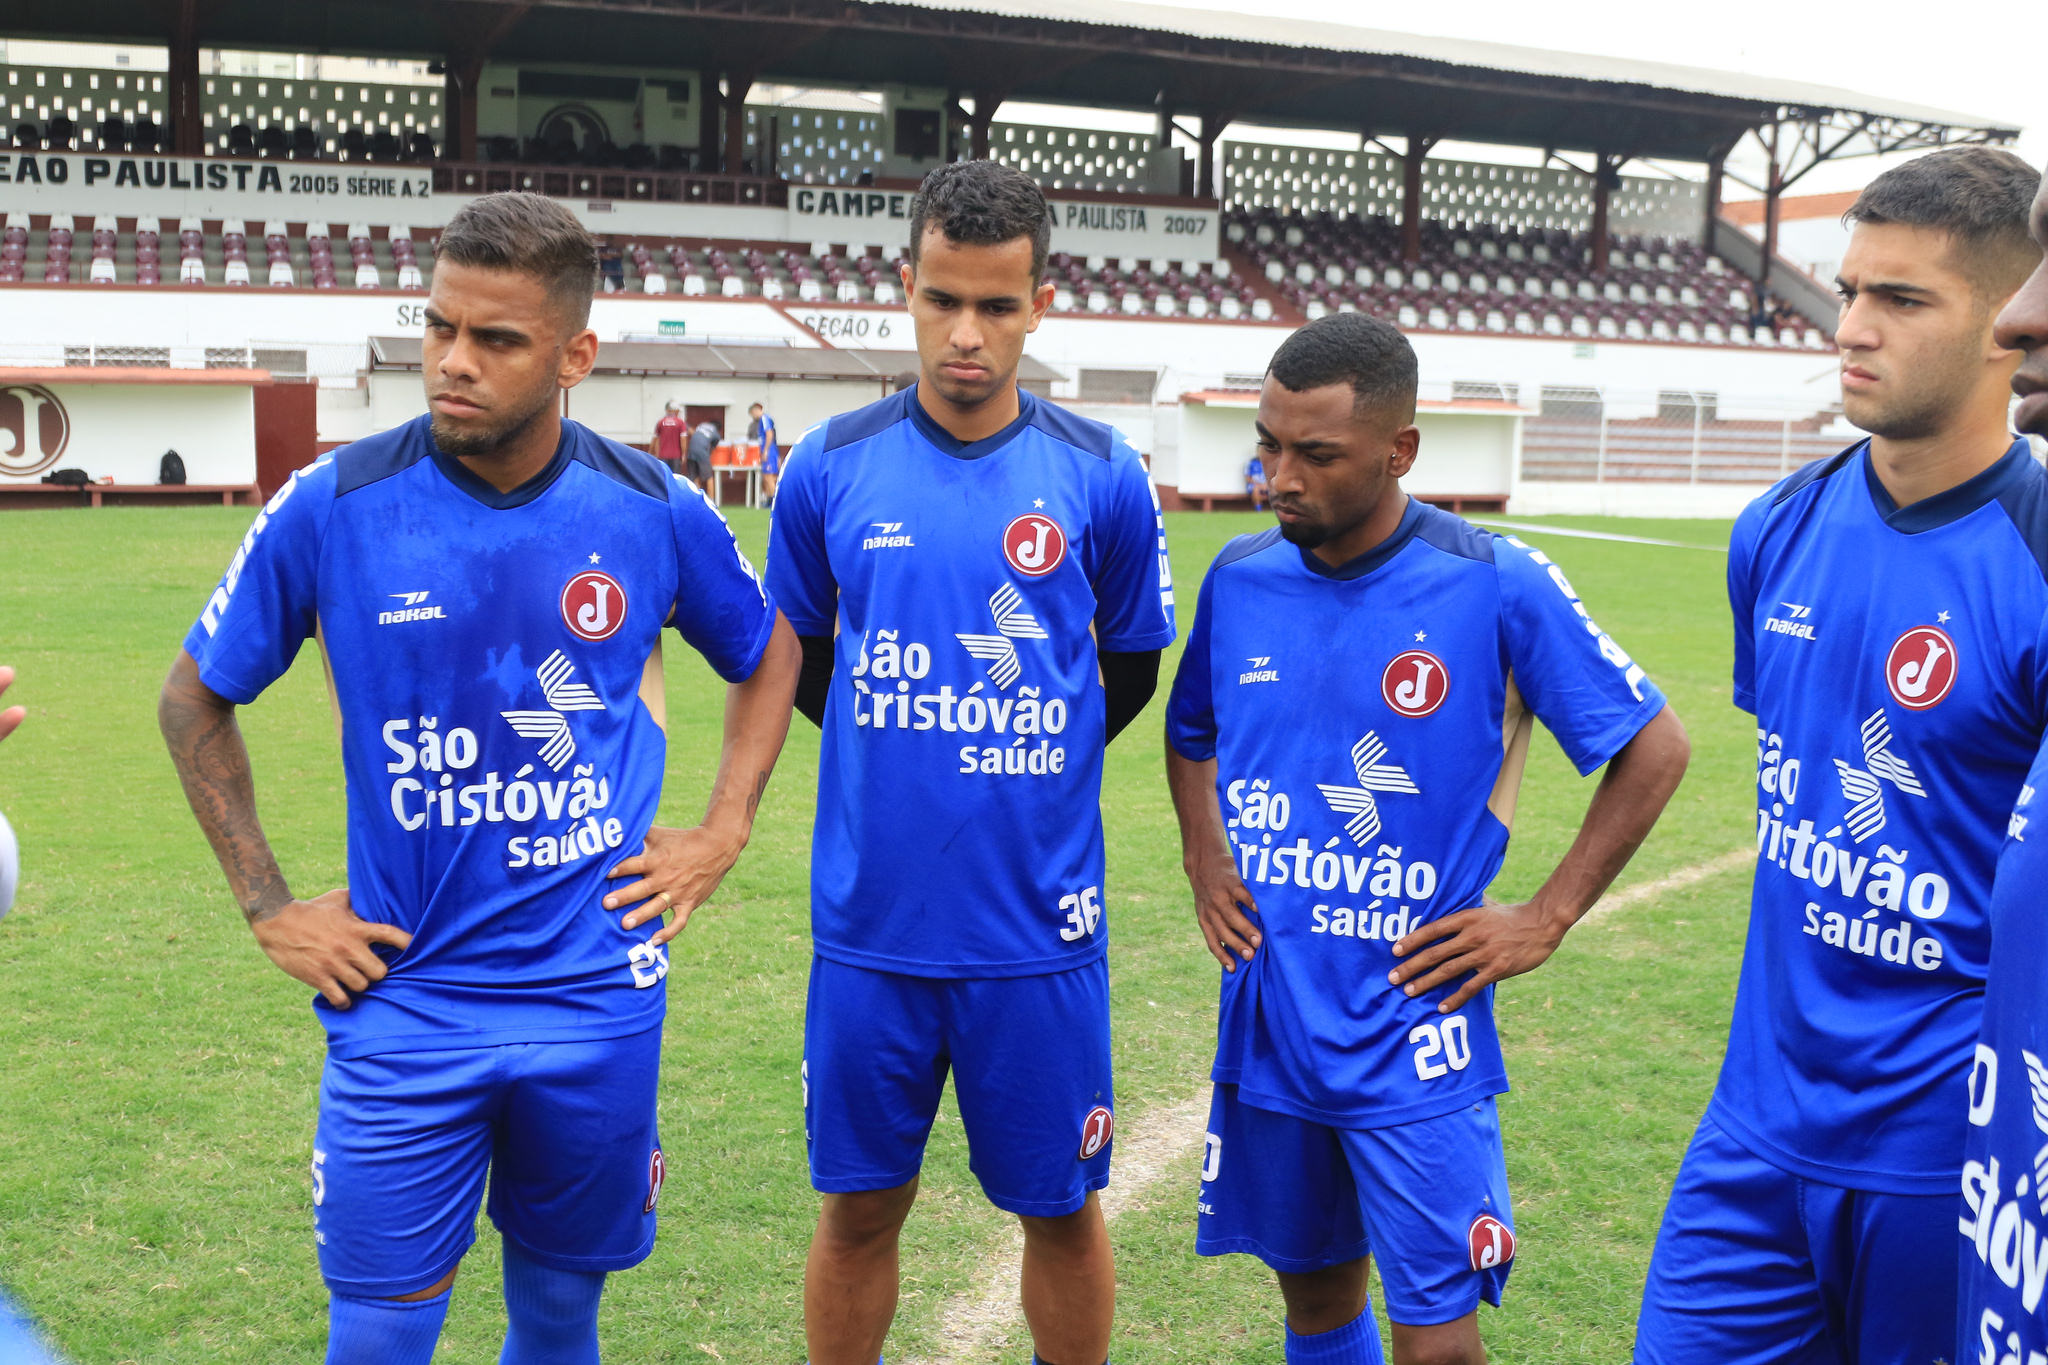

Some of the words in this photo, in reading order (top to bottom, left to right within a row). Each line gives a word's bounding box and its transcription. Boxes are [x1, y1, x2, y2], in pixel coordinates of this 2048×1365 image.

[84, 158, 282, 193] PAULISTA
[289, 175, 339, 195] 2005
[796, 190, 912, 220] CAMPE
[1066, 204, 1147, 232] PAULISTA
[1164, 215, 1207, 235] 2007
[878, 318, 891, 337] 6
[1016, 521, 1051, 568] J
[577, 581, 611, 632] J
[1394, 660, 1433, 709] J
[1896, 638, 1946, 697] J
[853, 680, 1067, 735] Cristóvão
[382, 715, 478, 774] São
[959, 736, 1065, 774] saúde
[1227, 778, 1290, 831] São
[508, 816, 624, 868] saúde
[1230, 830, 1436, 900] ristóvão
[1058, 886, 1101, 942] 36
[1803, 901, 1943, 972] saúde
[1409, 1015, 1471, 1081] 20
